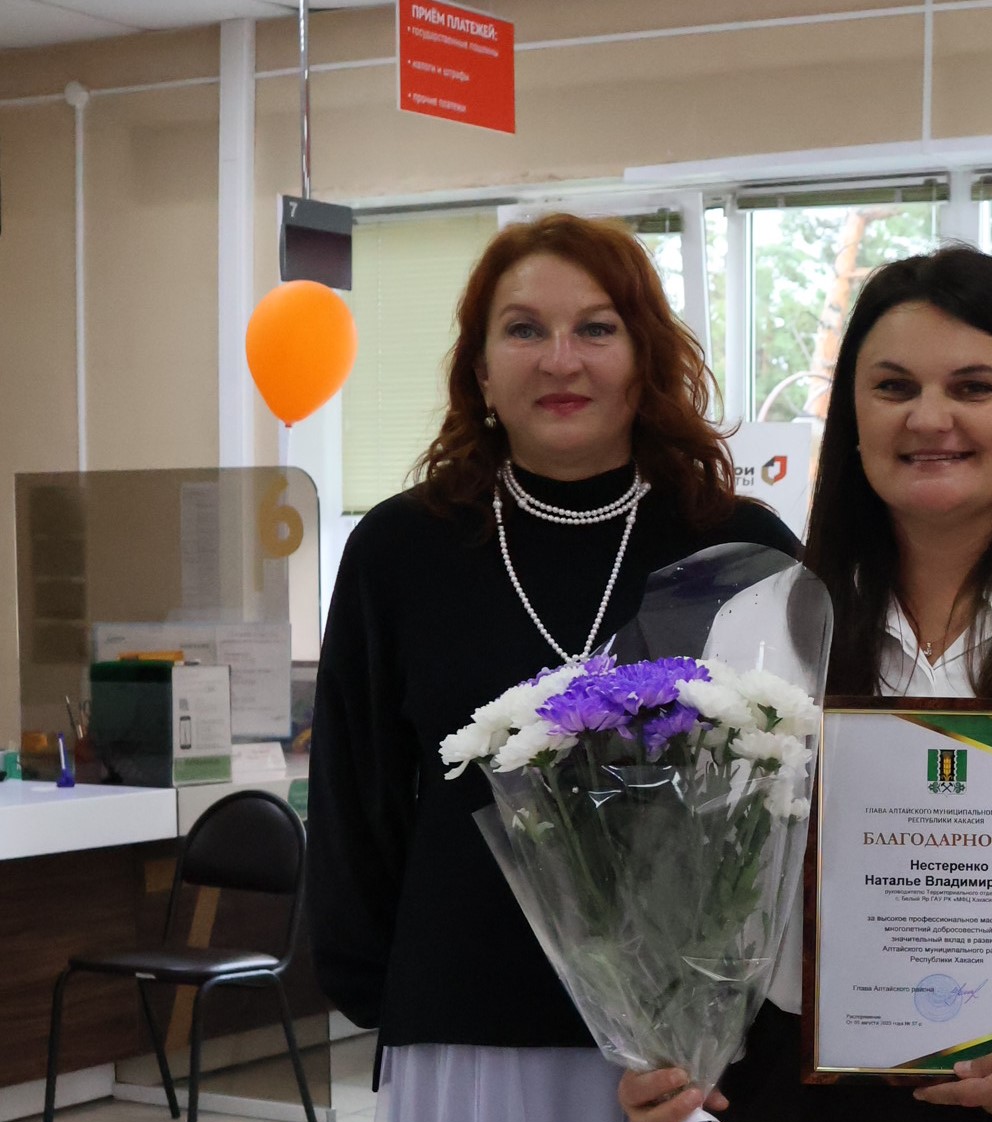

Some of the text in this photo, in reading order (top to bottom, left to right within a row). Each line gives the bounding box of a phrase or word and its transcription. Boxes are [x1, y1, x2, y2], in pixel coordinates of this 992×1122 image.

[412, 4, 498, 41] ПРИЁМ ПЛАТЕЖЕЙ:
[289, 201, 298, 217] 7
[257, 474, 304, 559] 6
[888, 807, 932, 815] АЛТАЙСКОГО
[907, 816, 952, 824] РЕСПУБЛИКИ
[910, 859, 989, 873] Нестеренко
[865, 874, 921, 887] Наталье
[908, 916, 979, 924] профессиональное
[884, 926, 931, 934] многолетний
[932, 926, 992, 935] добросовестный
[891, 936, 943, 944] значительный
[925, 947, 984, 955] муниципального
[910, 956, 953, 964] Республики
